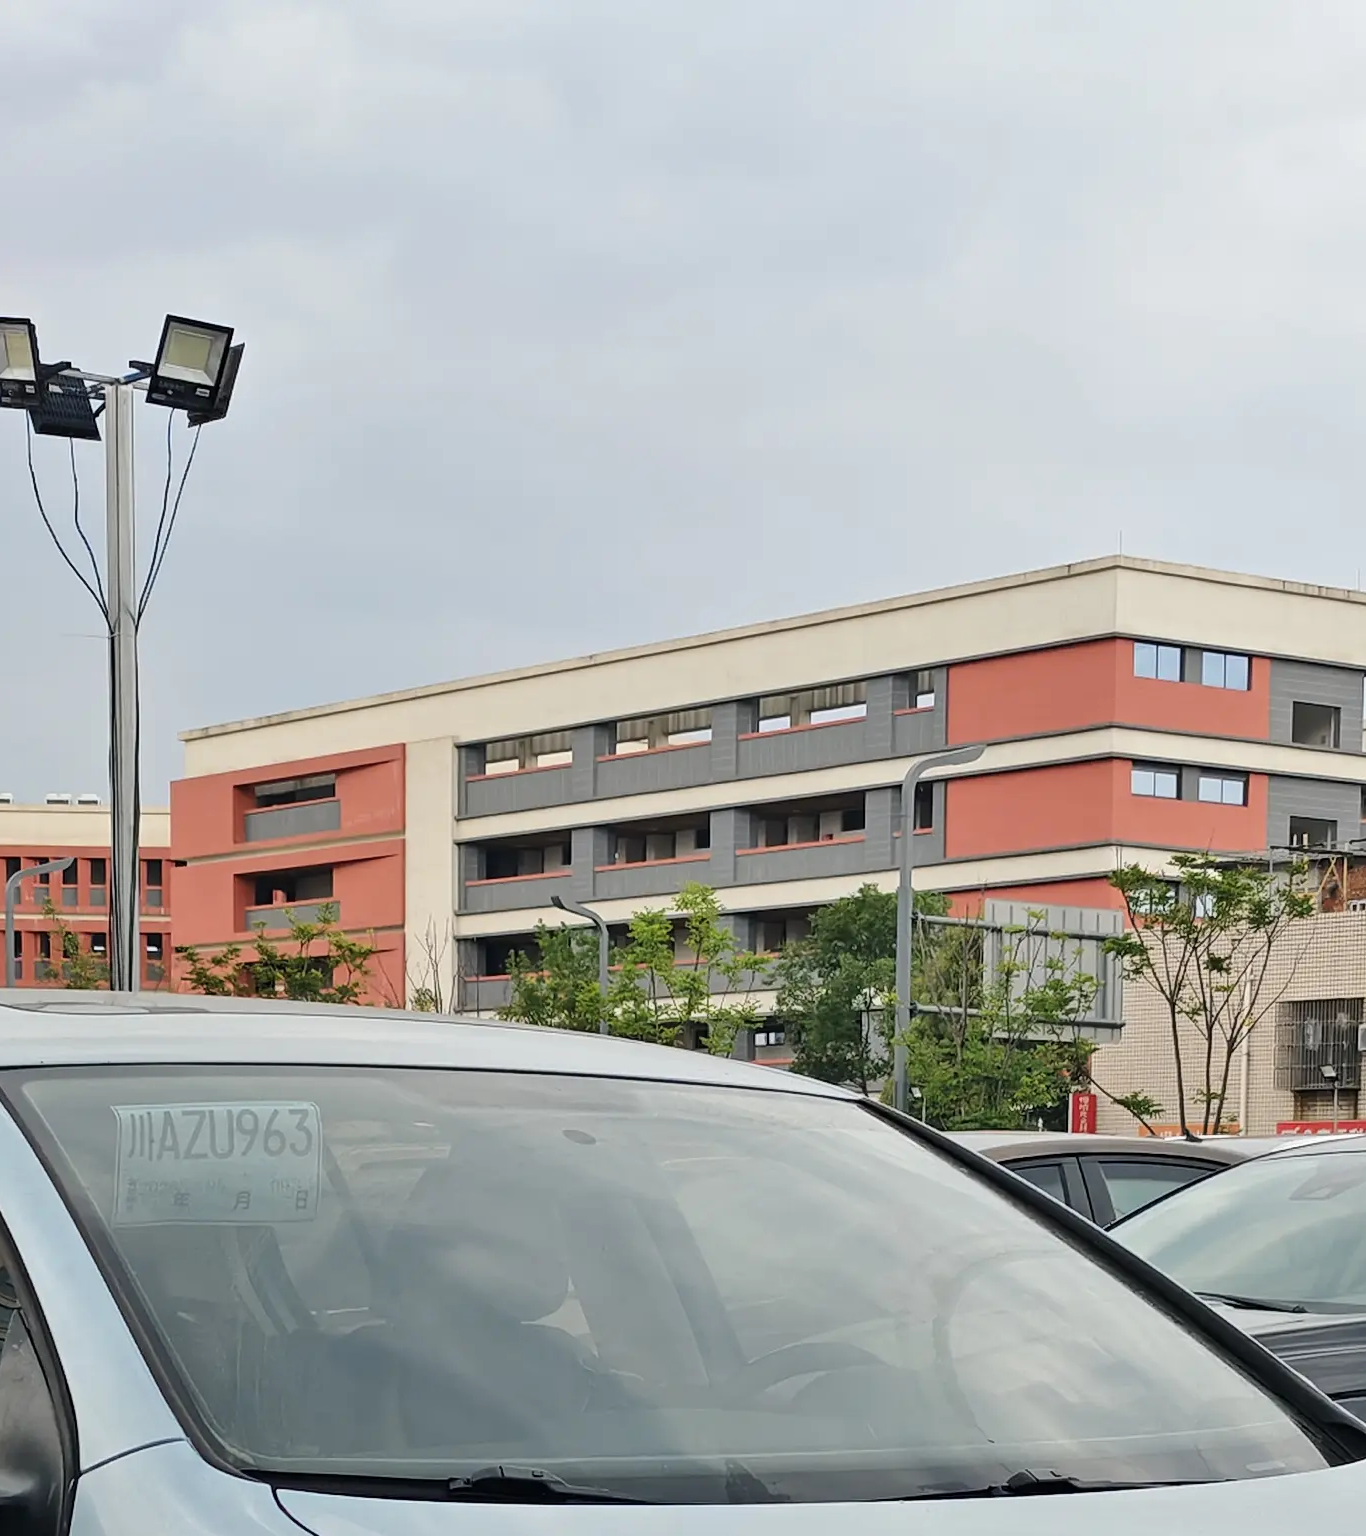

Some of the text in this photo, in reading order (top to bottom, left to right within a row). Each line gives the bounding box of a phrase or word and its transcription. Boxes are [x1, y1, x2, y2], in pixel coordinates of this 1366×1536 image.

[127, 1108, 313, 1162] 川AZU963
[232, 1190, 252, 1211] 月
[294, 1189, 310, 1211] 日
